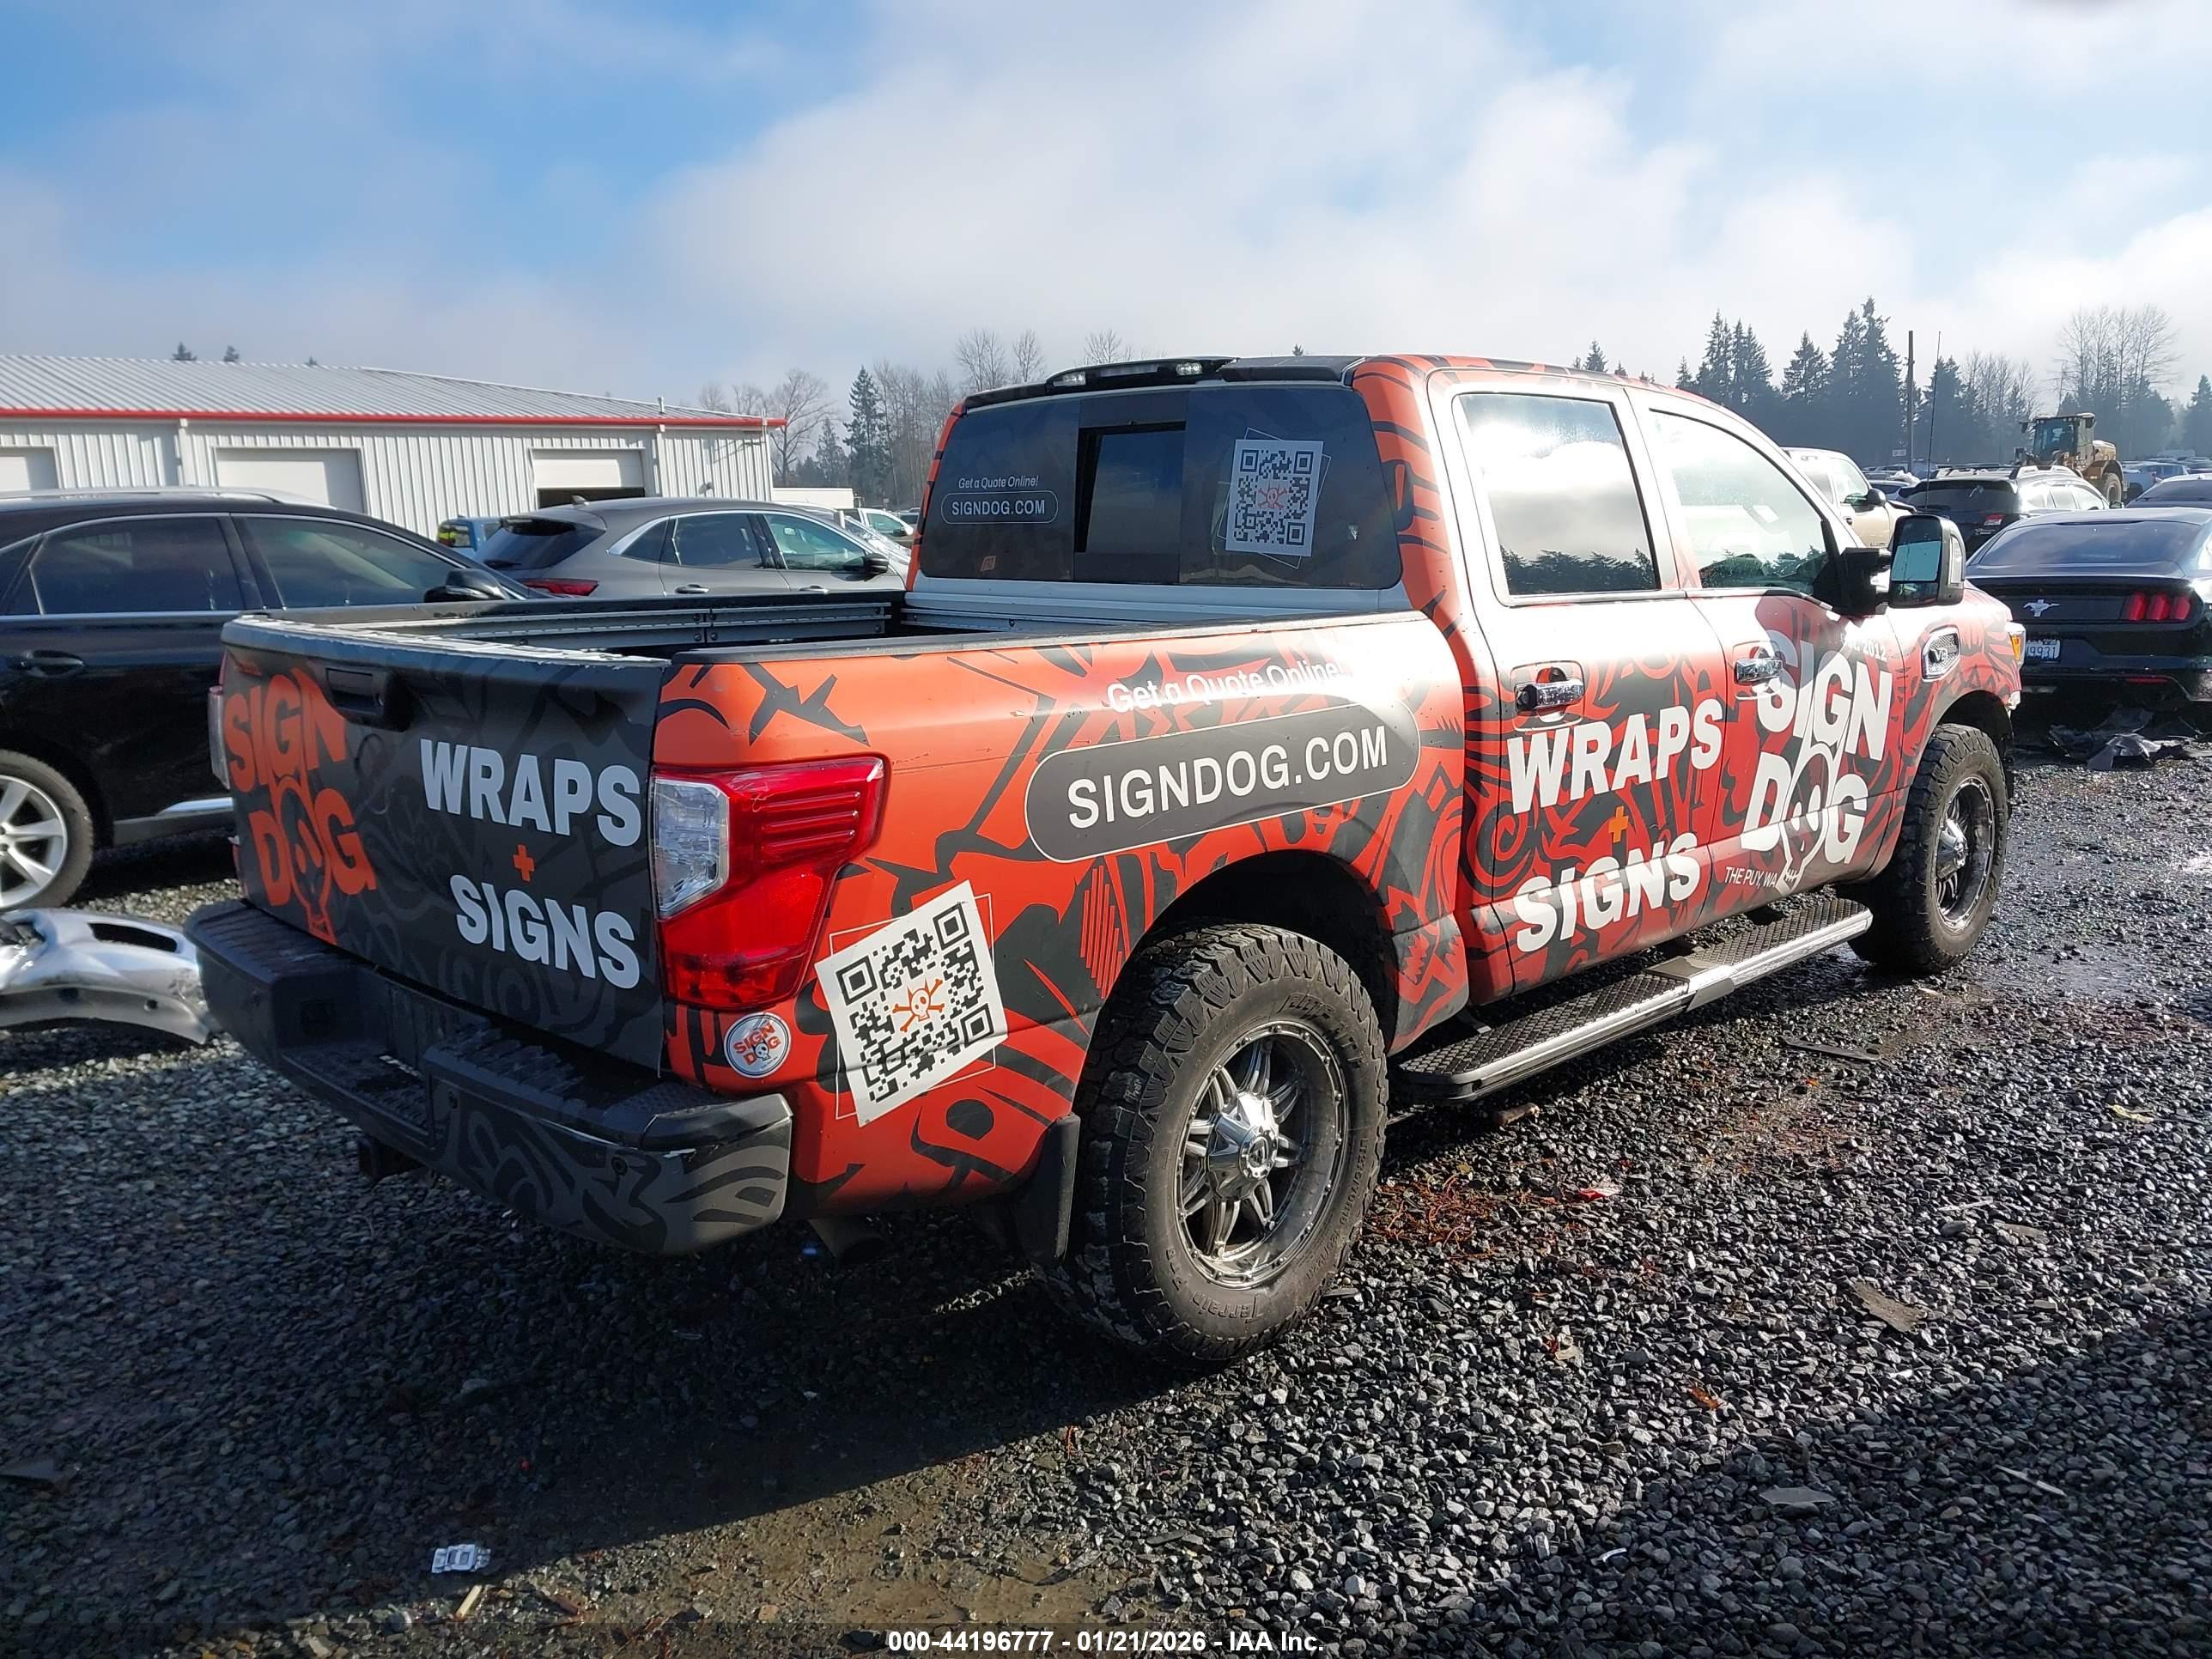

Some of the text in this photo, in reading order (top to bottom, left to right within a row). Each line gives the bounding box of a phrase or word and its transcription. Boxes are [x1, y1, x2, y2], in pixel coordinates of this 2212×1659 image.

[951, 499, 1046, 515] SIGNDOG.COM
[958, 475, 1039, 489] Get a Quote Online!
[224, 666, 349, 792] SIGN
[1107, 679, 1161, 714] Get
[1165, 681, 1183, 706] a
[1186, 669, 1266, 706] Quote
[1756, 629, 1893, 762] SIGN
[420, 738, 642, 847] WRAPS
[1067, 725, 1389, 829] SIGNDOG.COM
[1507, 698, 1723, 815] WRAPS
[1512, 832, 1701, 952] SIGNS
[1724, 866, 1778, 890] THE PUY, WA
[449, 874, 641, 989] SIGNS
[732, 1021, 776, 1054] SIGN
[1192, 1291, 1264, 1324] Terrain
